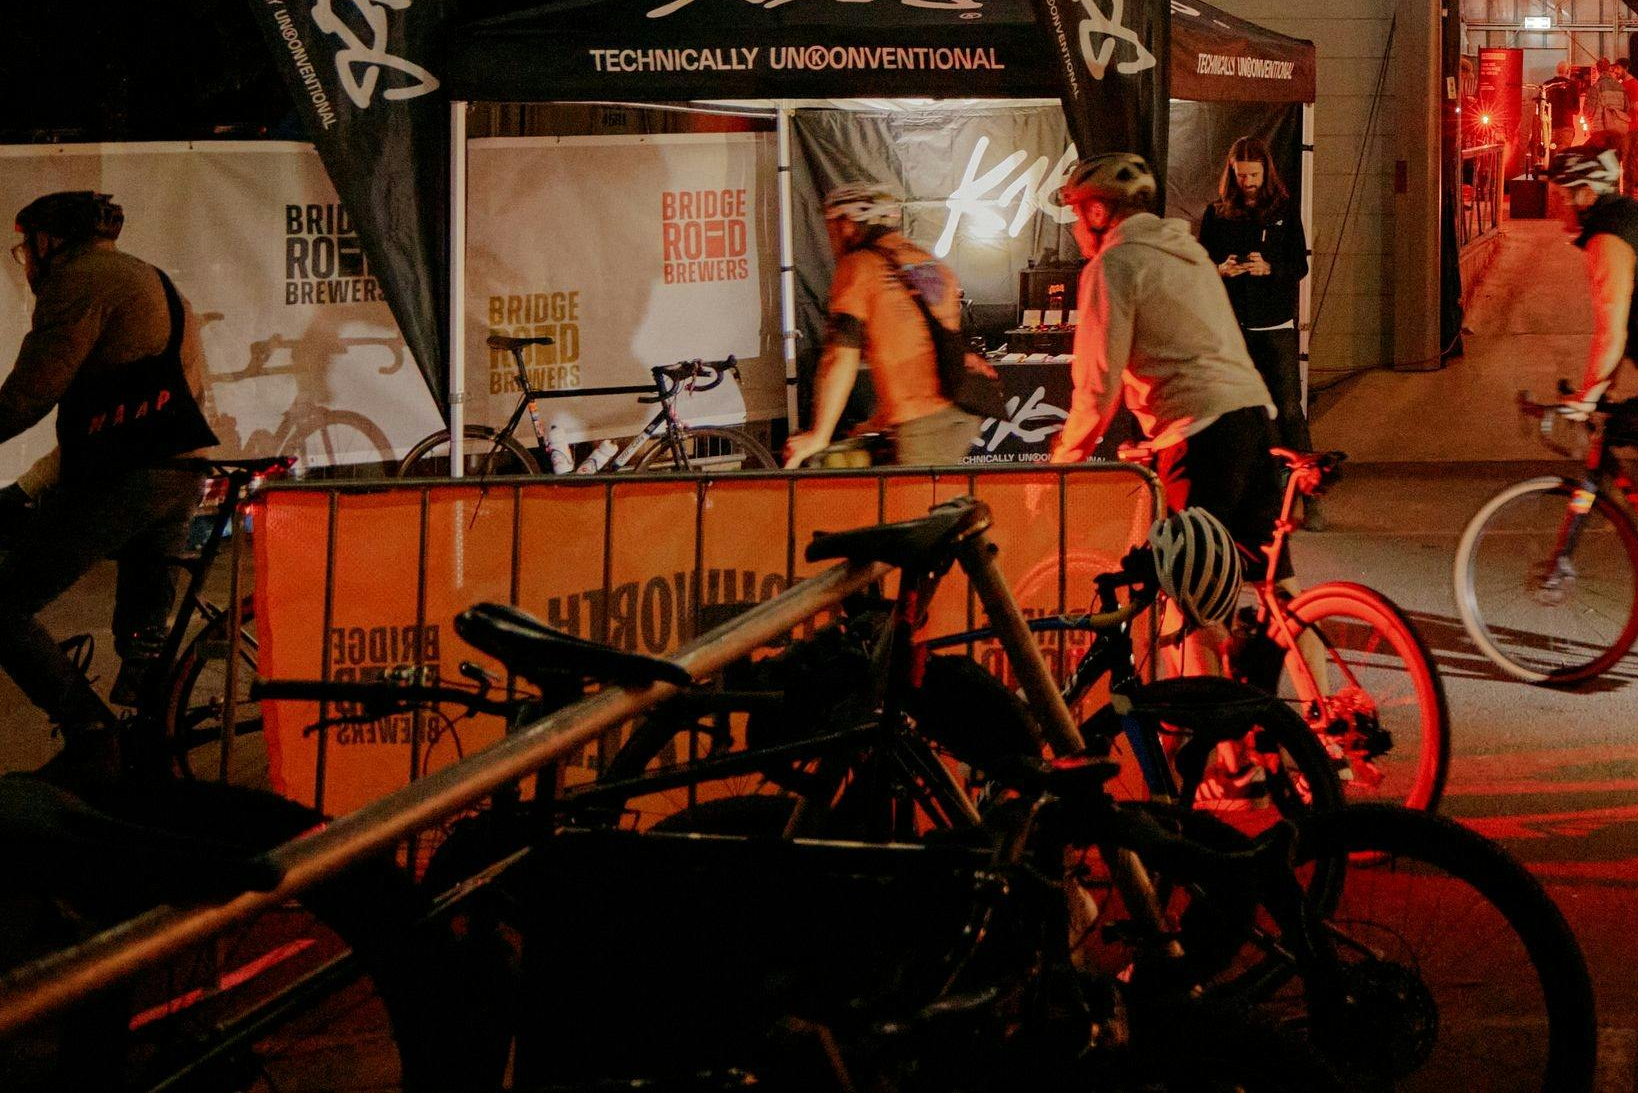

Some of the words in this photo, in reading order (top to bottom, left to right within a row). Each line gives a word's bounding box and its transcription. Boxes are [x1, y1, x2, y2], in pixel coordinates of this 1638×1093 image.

[590, 47, 759, 72] TECHNICALLY
[286, 204, 355, 235] BRID
[662, 189, 747, 221] BRIDGE
[662, 219, 747, 261] ROAD
[664, 259, 749, 286] BREWERS
[285, 278, 385, 305] BREWER
[489, 290, 580, 325] BRIDGE
